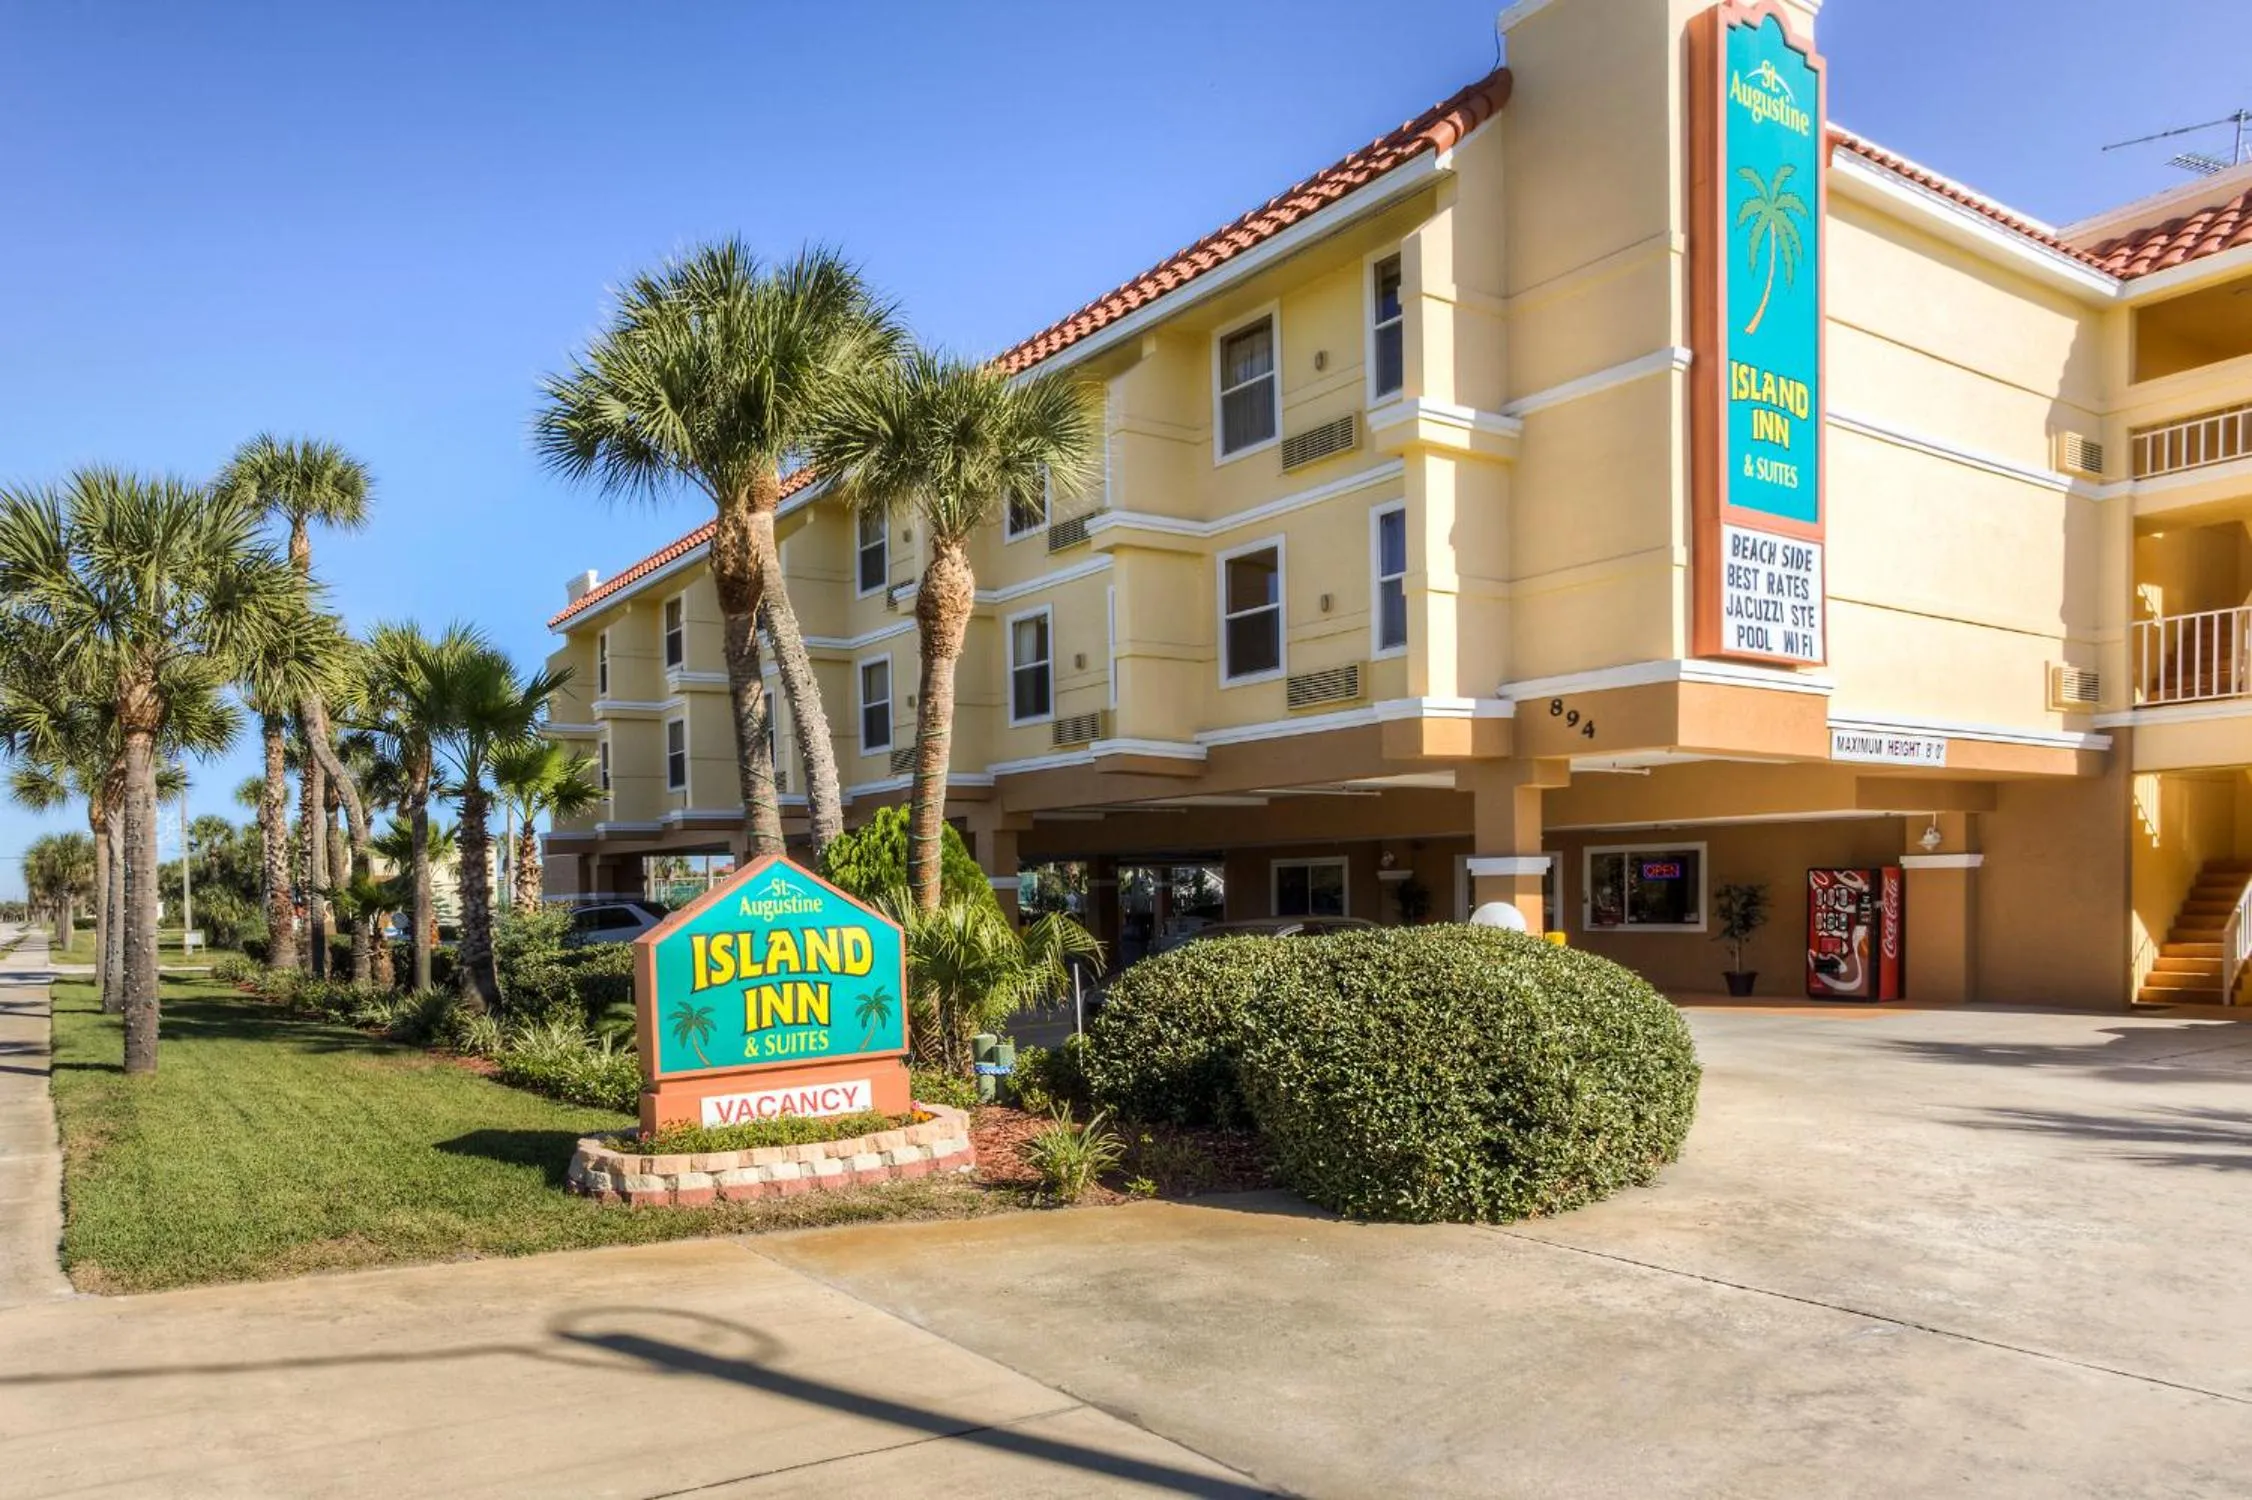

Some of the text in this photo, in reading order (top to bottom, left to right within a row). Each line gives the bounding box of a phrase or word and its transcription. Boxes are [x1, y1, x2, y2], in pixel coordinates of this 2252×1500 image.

[1762, 59, 1780, 93] St.
[1729, 69, 1810, 136] Augustine
[1729, 359, 1809, 421] ISLAND
[1752, 408, 1790, 451] INN
[1744, 453, 1798, 489] & SUITES
[1732, 534, 1813, 572] BEACH SIDE
[1727, 563, 1809, 600] BEST RATES
[1726, 593, 1815, 628] JACUZZI STE
[1737, 624, 1773, 652] POOL
[1550, 698, 1596, 740] 894
[1837, 736, 1882, 755] MAXIMUM
[1887, 739, 1921, 757] HEIGHT
[1645, 863, 1678, 878] OPEN
[739, 894, 823, 922] Augustine
[690, 926, 874, 994] ISLAND
[743, 980, 832, 1035] INN
[744, 1030, 829, 1057] & SUITES
[715, 1086, 859, 1125] VACANCY
